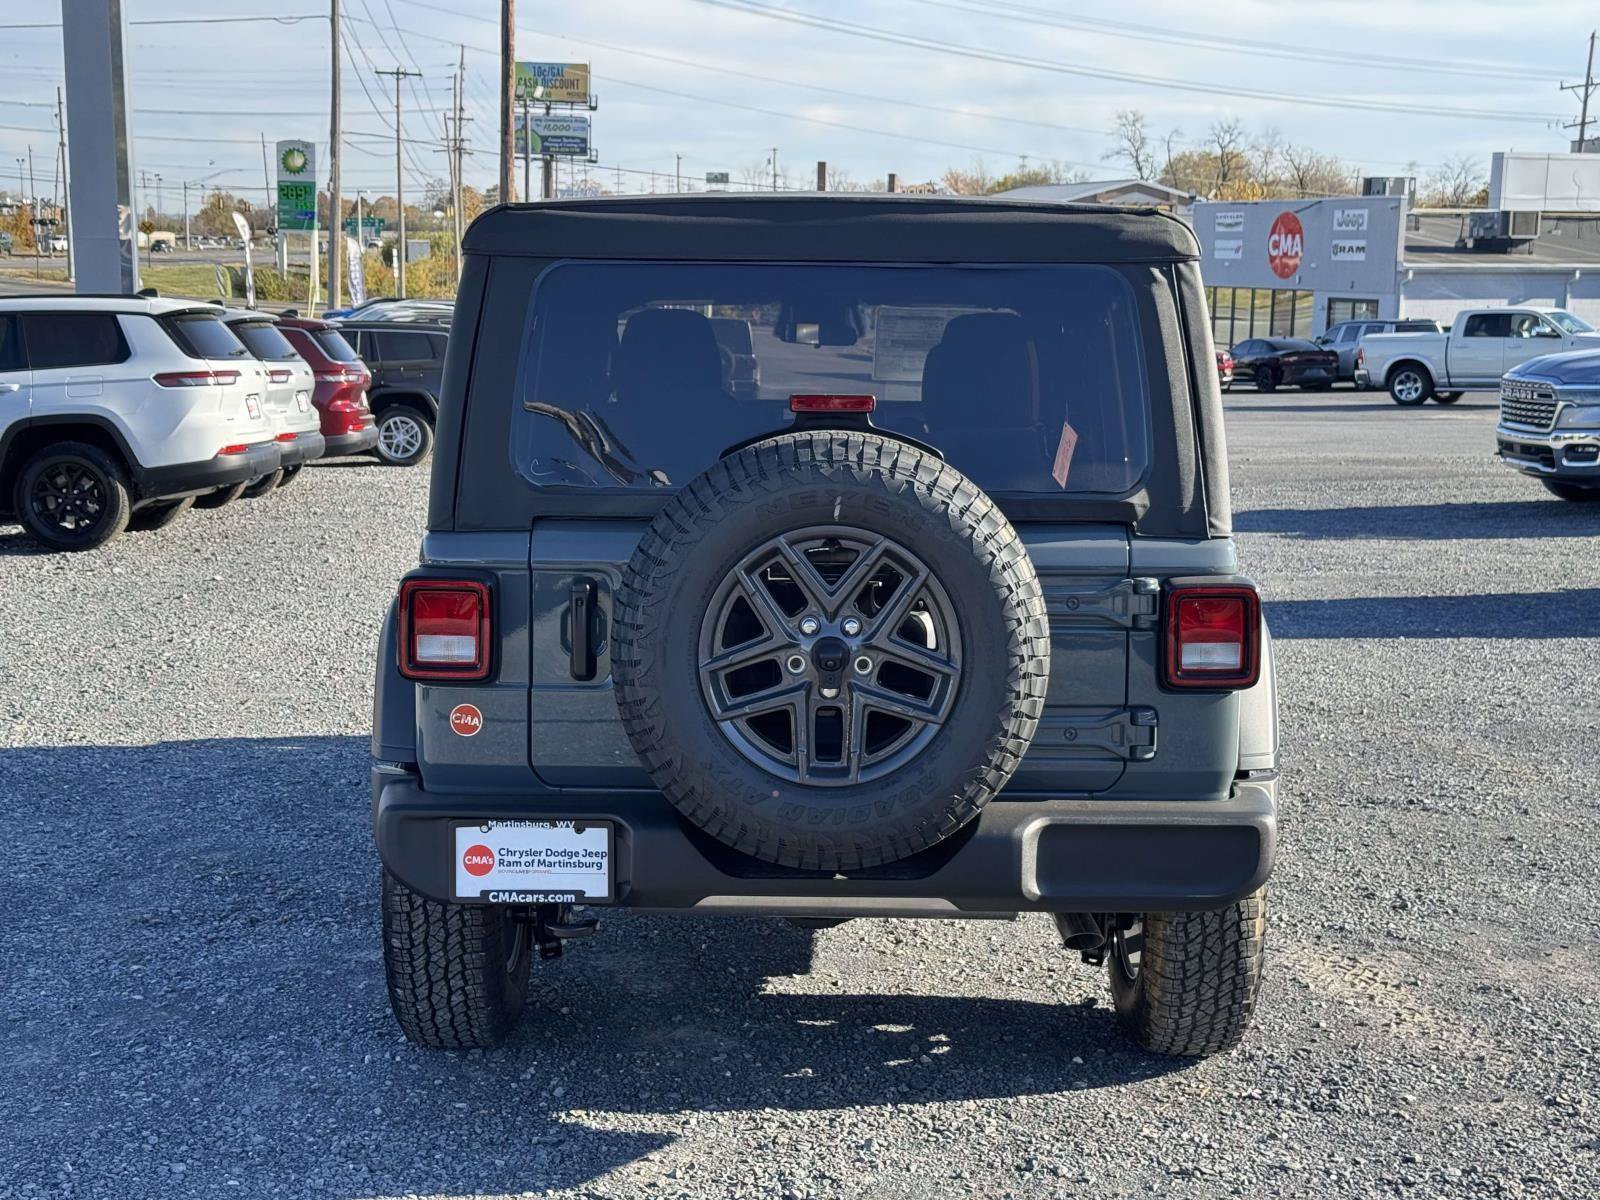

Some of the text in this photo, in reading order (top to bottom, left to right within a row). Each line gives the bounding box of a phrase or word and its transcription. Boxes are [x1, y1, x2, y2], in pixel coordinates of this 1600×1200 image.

[541, 78, 580, 90] DISCOUNT
[1336, 209, 1365, 231] Jeep
[1268, 233, 1303, 257] CMA
[1338, 246, 1366, 255] RAM
[452, 713, 480, 727] CMA
[488, 820, 576, 830] Martinsburg, WV
[464, 855, 494, 865] CMA's
[498, 848, 608, 860] Chrysler Dodge Jeep
[498, 859, 603, 871] Ram of Martinsburg
[488, 891, 576, 903] CMAcars.com
